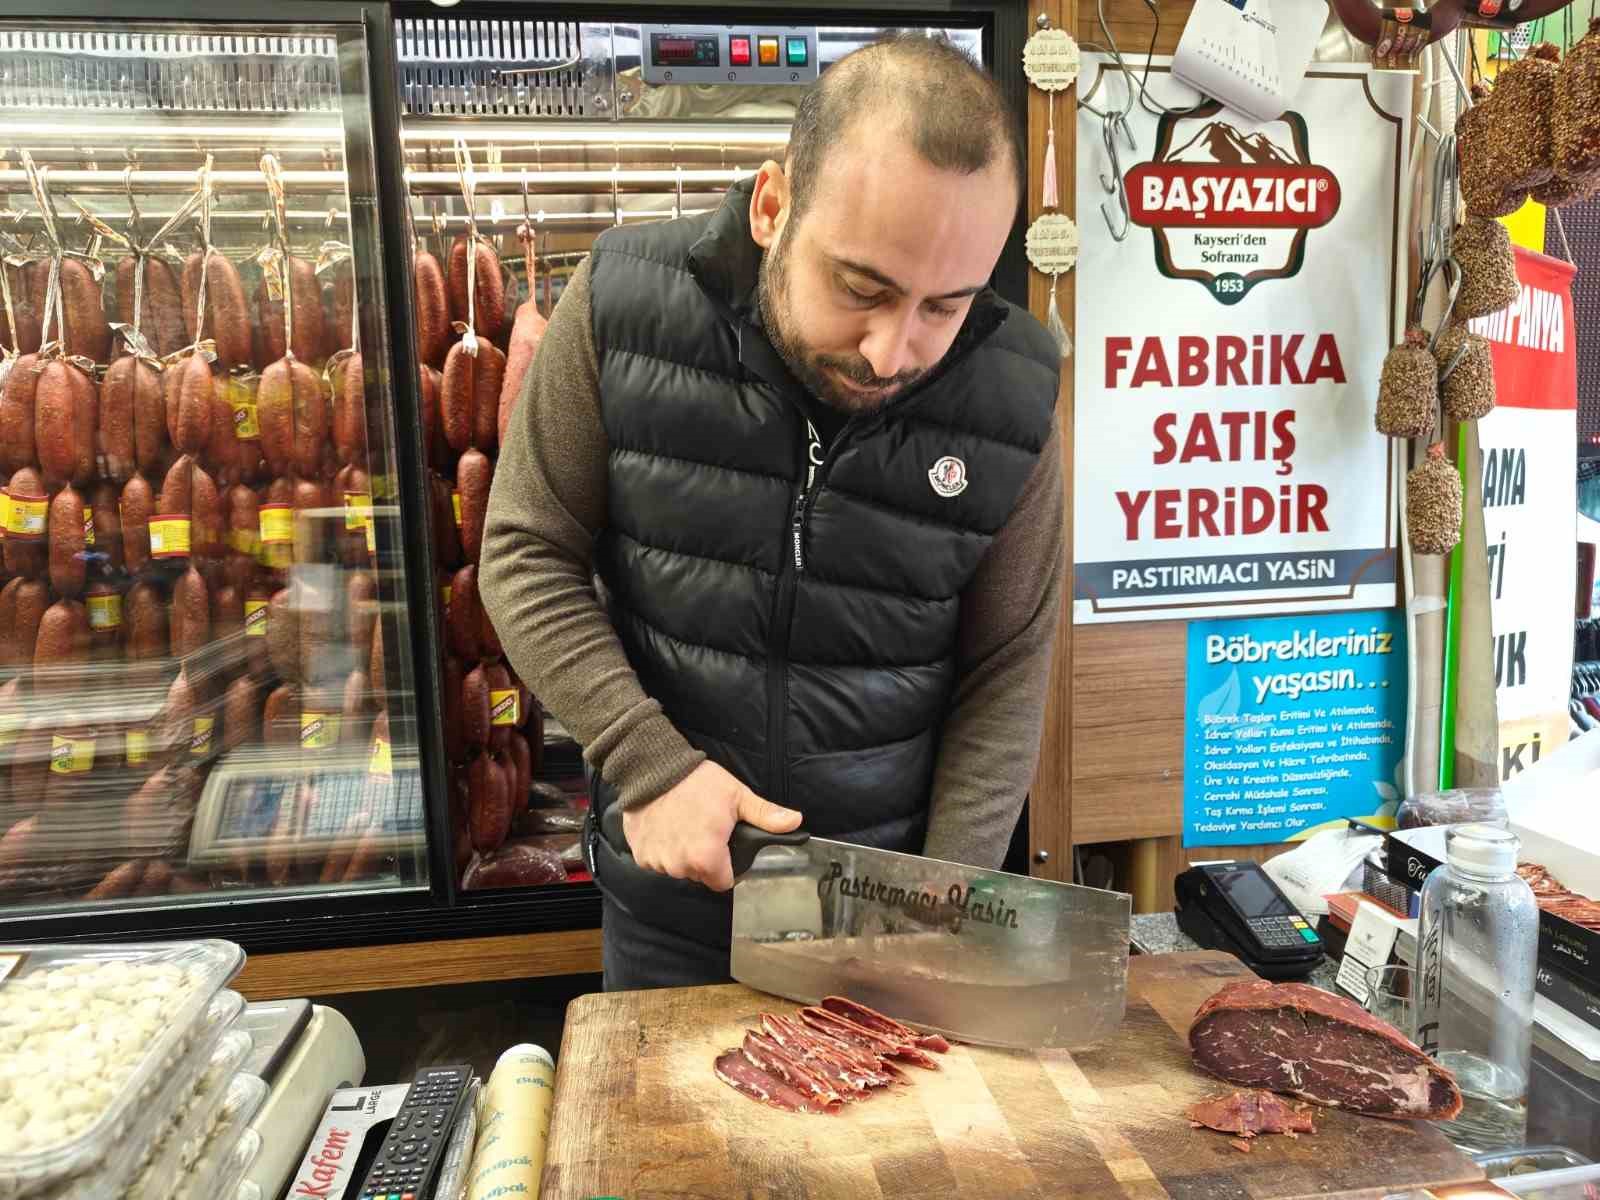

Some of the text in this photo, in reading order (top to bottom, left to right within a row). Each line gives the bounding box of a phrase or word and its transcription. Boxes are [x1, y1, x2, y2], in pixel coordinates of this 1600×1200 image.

[1194, 233, 1267, 248] Kayseri'den
[1216, 279, 1244, 293] 1953
[1153, 410, 1296, 475] SATIŞ
[1480, 448, 1526, 507] ANA
[1112, 563, 1258, 590] PASTIRMACI
[1206, 627, 1392, 664] Böbrekleriniz
[948, 884, 1018, 934] Yasin
[331, 1096, 366, 1111] L
[364, 1090, 382, 1114] LARGE
[296, 1127, 351, 1197] Kafem
